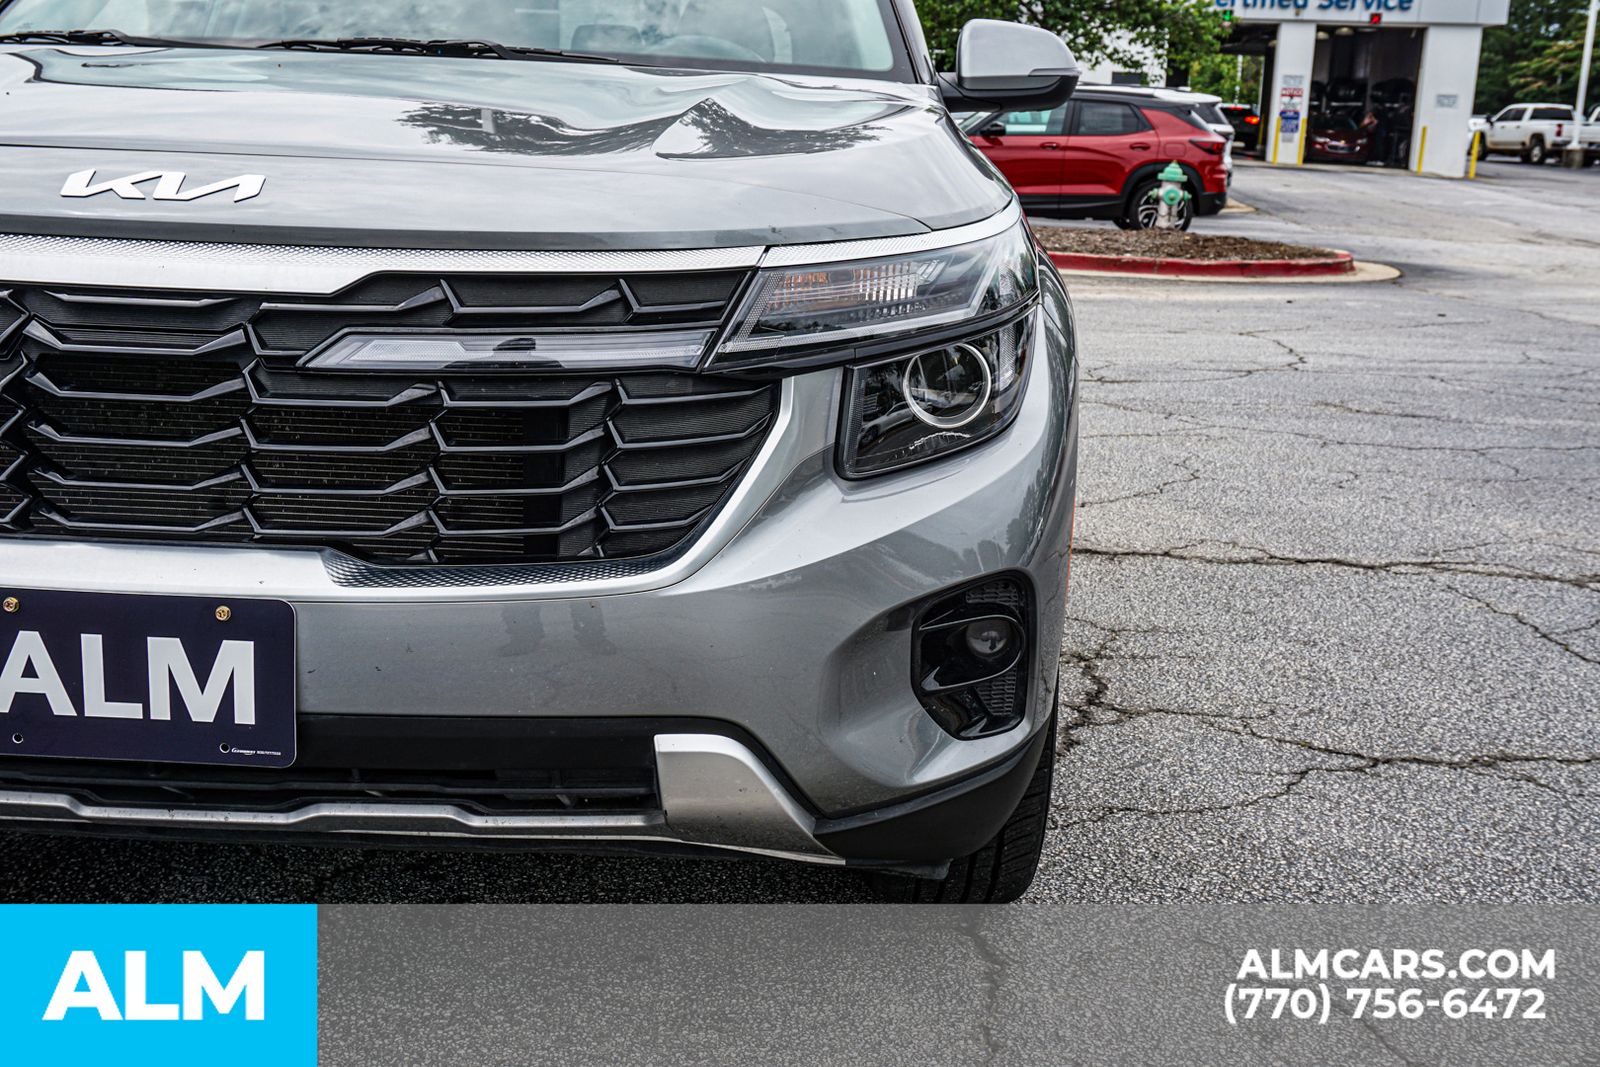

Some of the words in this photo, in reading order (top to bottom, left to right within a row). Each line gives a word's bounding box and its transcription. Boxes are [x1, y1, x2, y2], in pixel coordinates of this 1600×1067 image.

[1215, 0, 1308, 9] ertified
[61, 168, 266, 203] KIA
[0, 630, 256, 725] ALM
